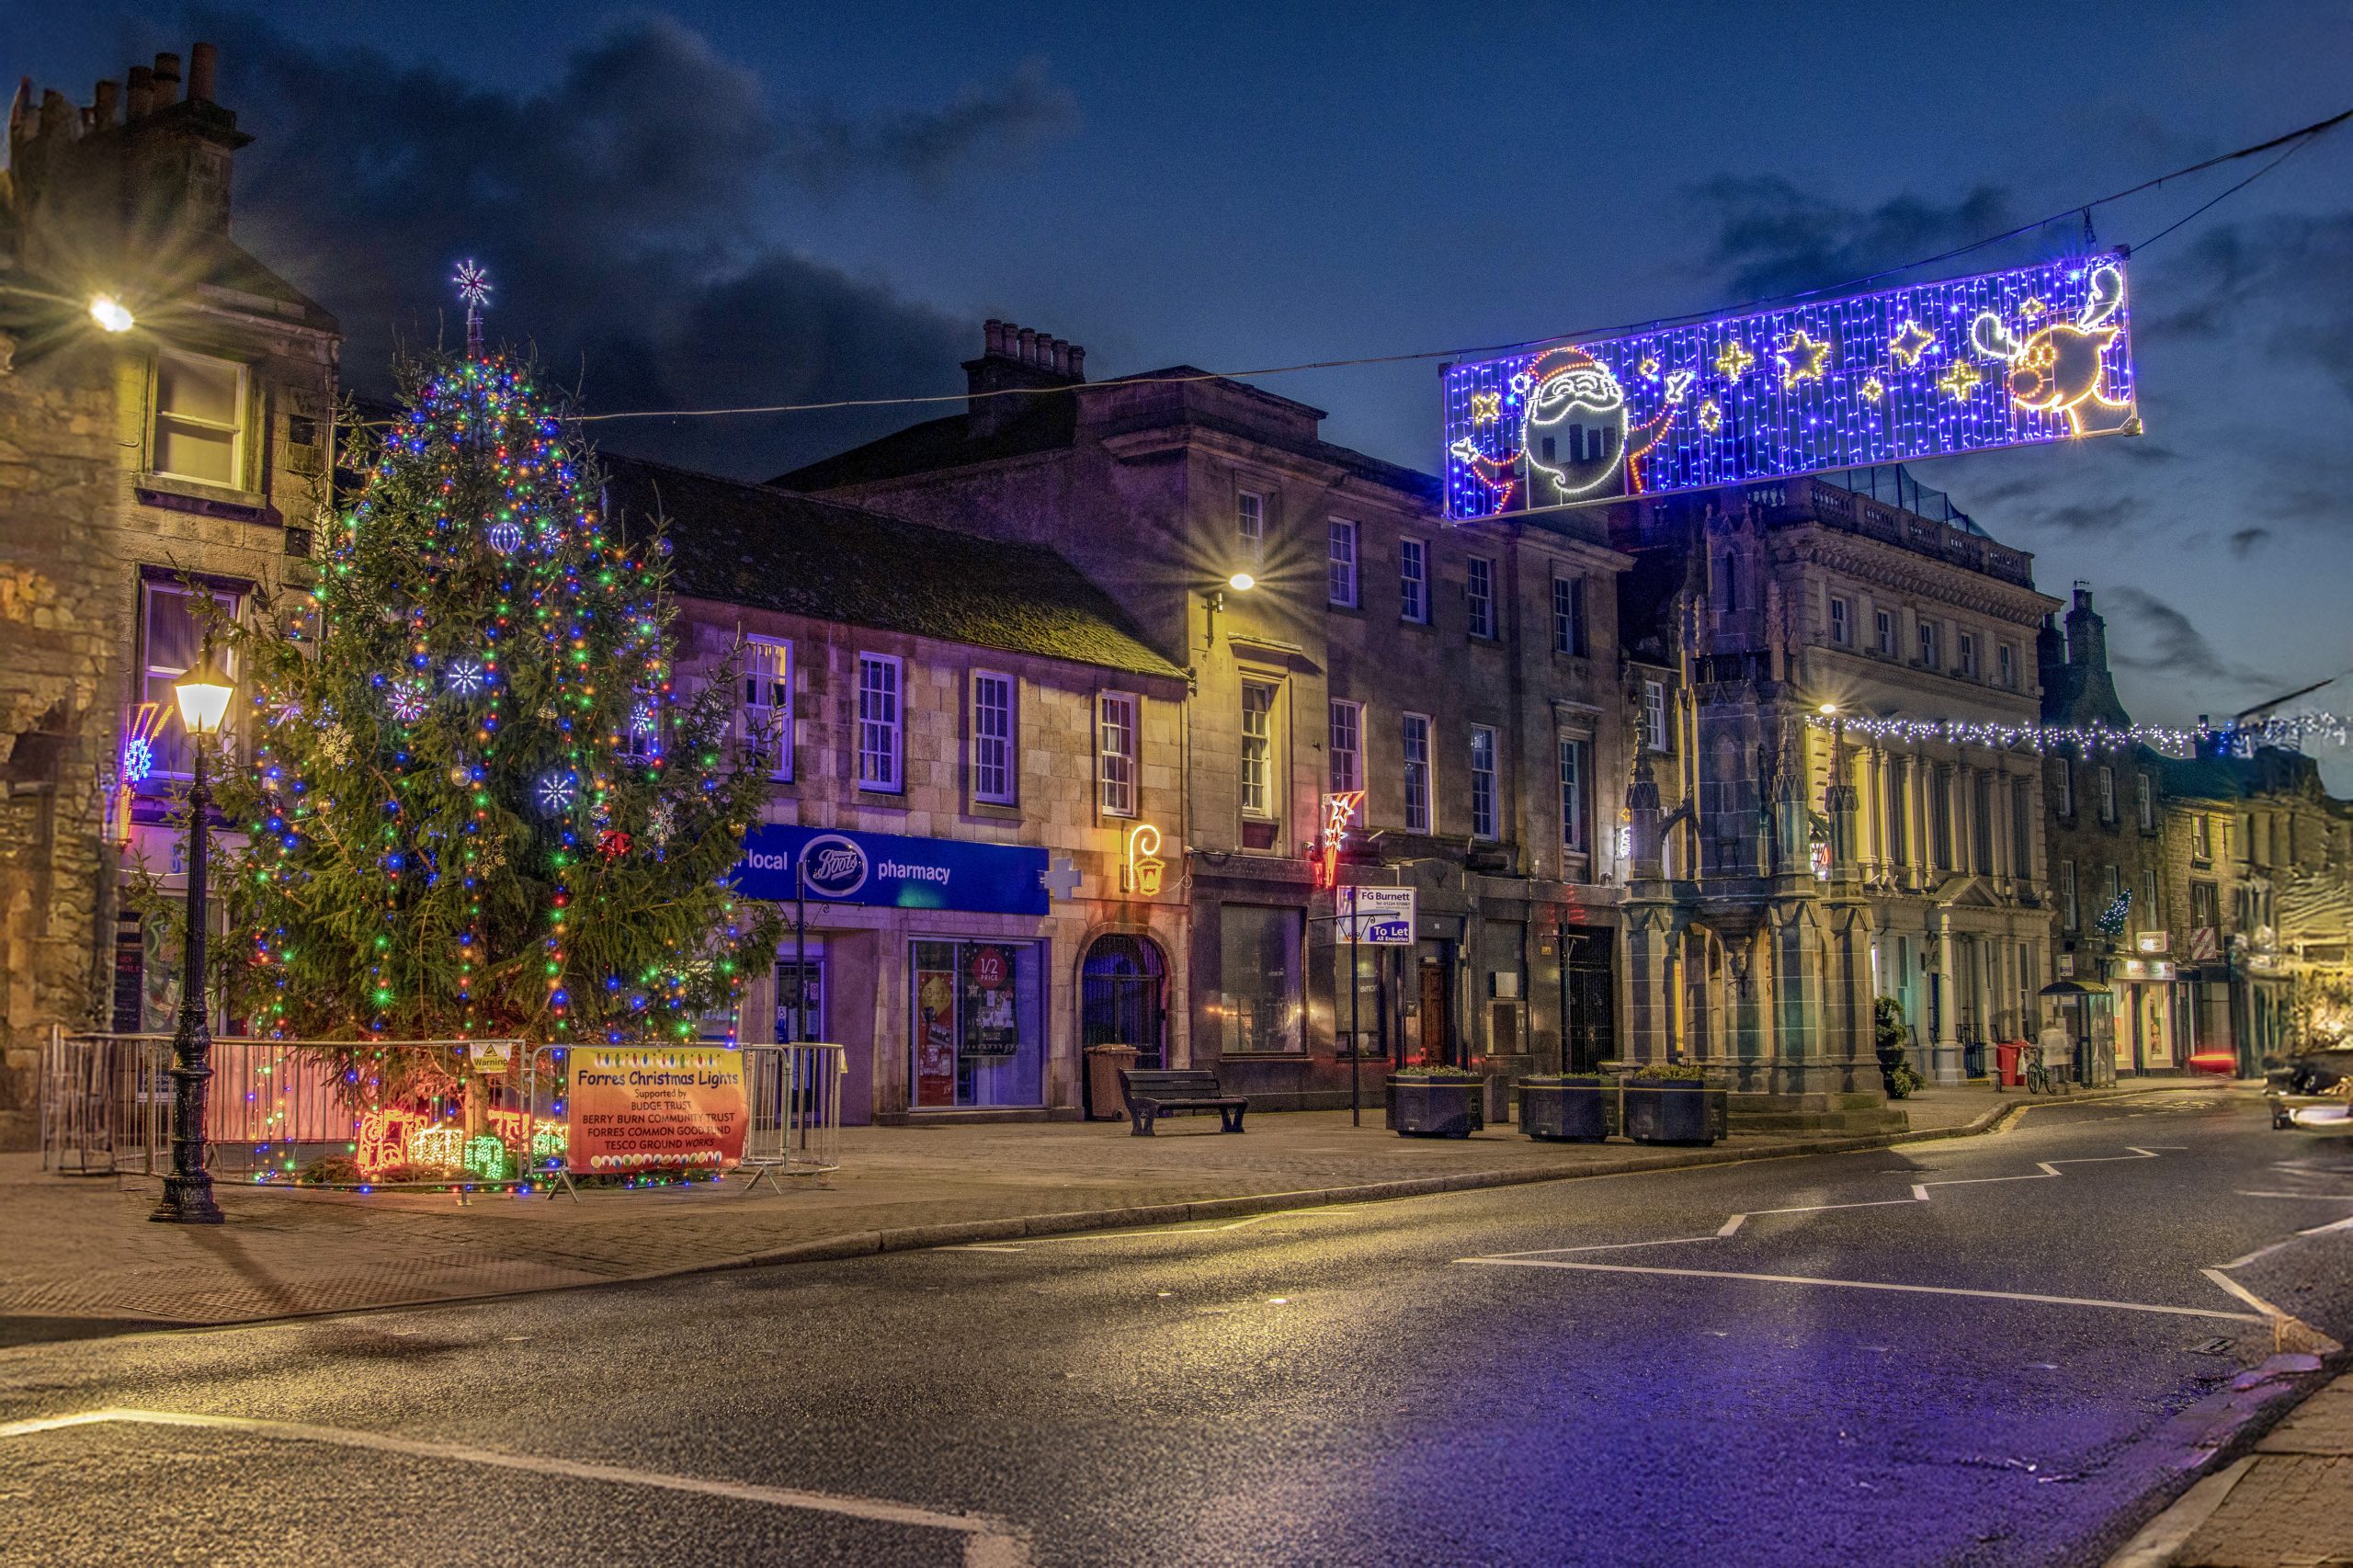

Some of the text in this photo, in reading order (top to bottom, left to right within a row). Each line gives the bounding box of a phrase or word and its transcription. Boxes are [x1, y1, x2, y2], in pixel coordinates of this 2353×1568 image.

[748, 848, 788, 870] local
[813, 849, 858, 881] Boots
[878, 859, 950, 885] pharmacy
[1361, 892, 1410, 901] FG Burnett
[1373, 926, 1408, 937] To Let
[981, 958, 998, 974] 1/2
[474, 1058, 509, 1066] Warning
[578, 1070, 739, 1088] Forres Christmas Lights
[635, 1089, 688, 1099] Supported by
[631, 1101, 691, 1111] BUDGE TRUST
[583, 1112, 735, 1124] BERRY BURN COMMUNITY TRUST
[587, 1126, 732, 1137] FORRES COMMON GOOD FUND
[604, 1138, 716, 1150] TESCO GROUND WORKS
